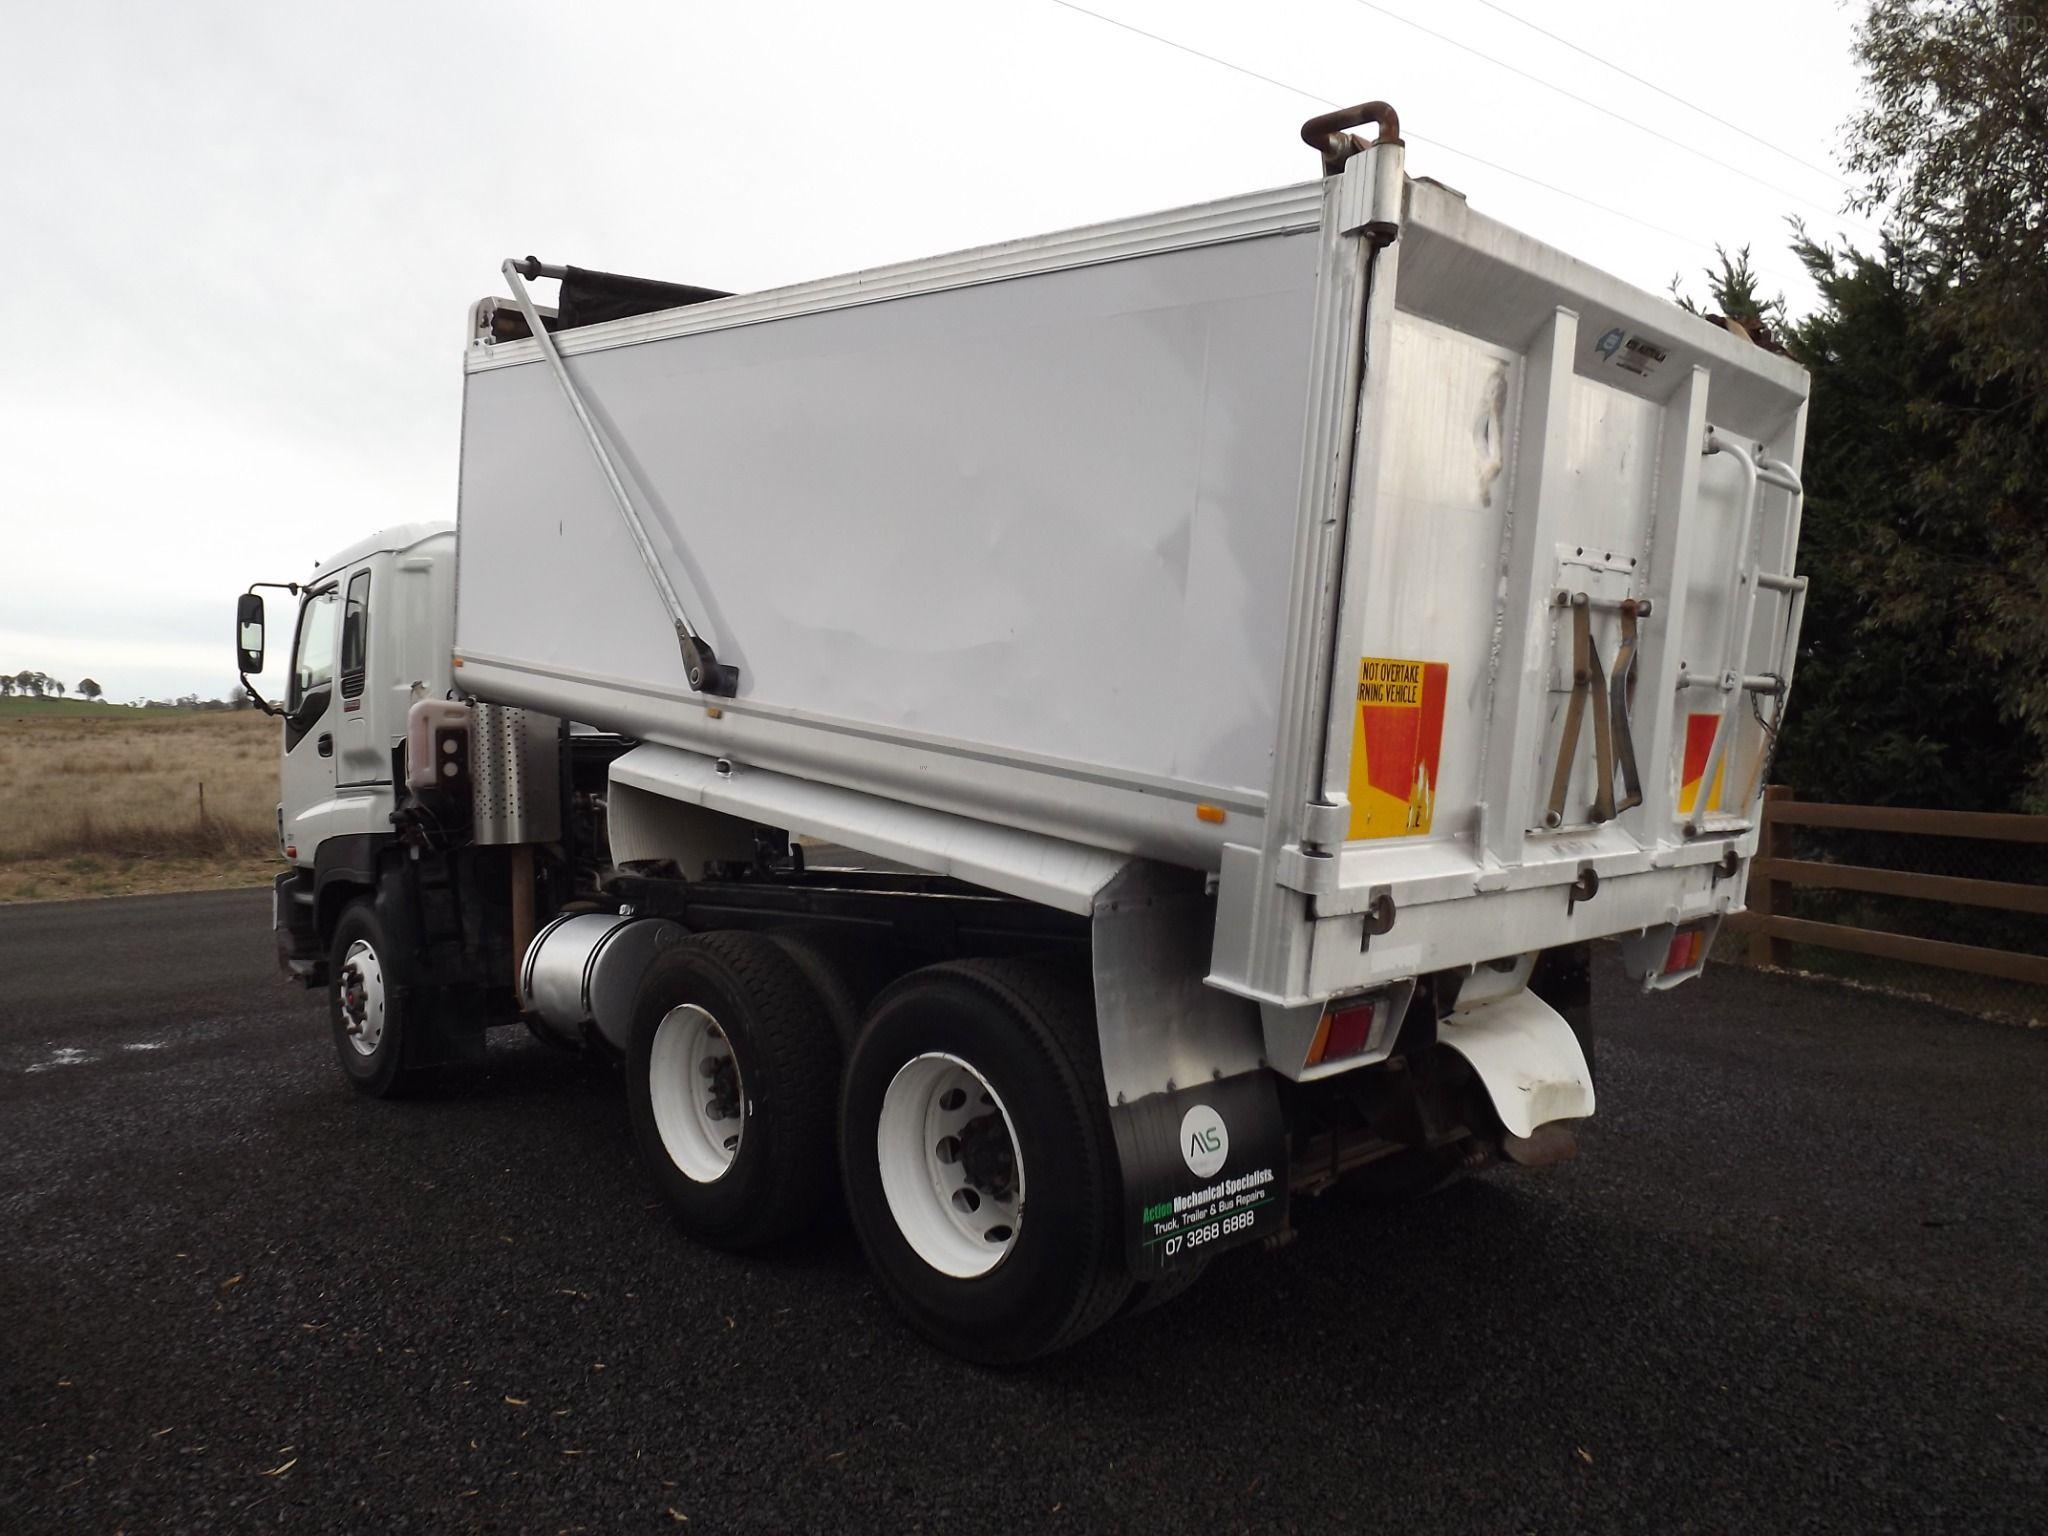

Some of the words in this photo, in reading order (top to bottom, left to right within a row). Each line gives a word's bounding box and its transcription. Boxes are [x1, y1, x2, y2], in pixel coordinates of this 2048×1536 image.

[1362, 662, 1379, 681] NOT
[1380, 663, 1419, 683] OVERTAKE
[1385, 684, 1417, 703] VEHICLE
[1143, 1201, 1172, 1224] Action
[1173, 1181, 1224, 1213] Mechanical
[1182, 1208, 1208, 1225] Trailer
[1210, 1203, 1217, 1216] &
[1218, 1200, 1234, 1213] Bus
[1235, 1189, 1265, 1207] Repairs
[1165, 1235, 1183, 1256] 07
[1186, 1222, 1219, 1248] 3268
[1223, 1210, 1254, 1235] 6888
